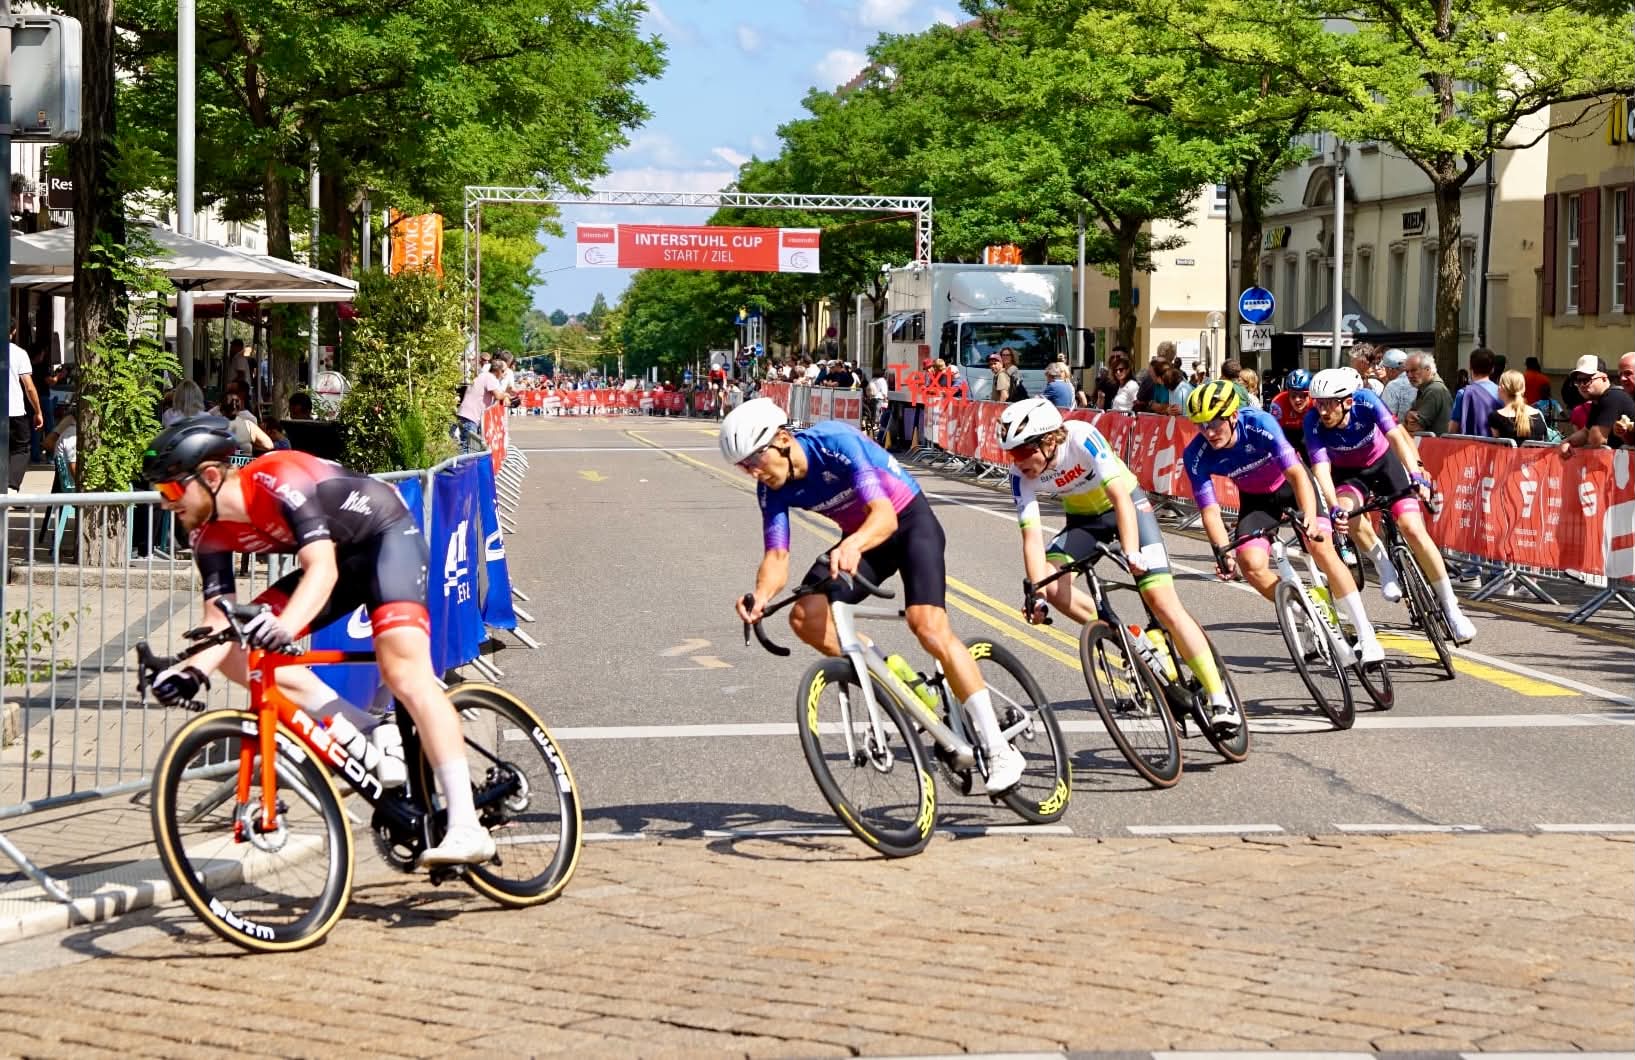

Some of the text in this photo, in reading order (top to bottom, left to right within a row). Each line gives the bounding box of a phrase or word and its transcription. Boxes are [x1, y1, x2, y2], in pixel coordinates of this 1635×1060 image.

[635, 233, 763, 248] INTERSTUHL CUP
[664, 249, 734, 263] START / ZIEL
